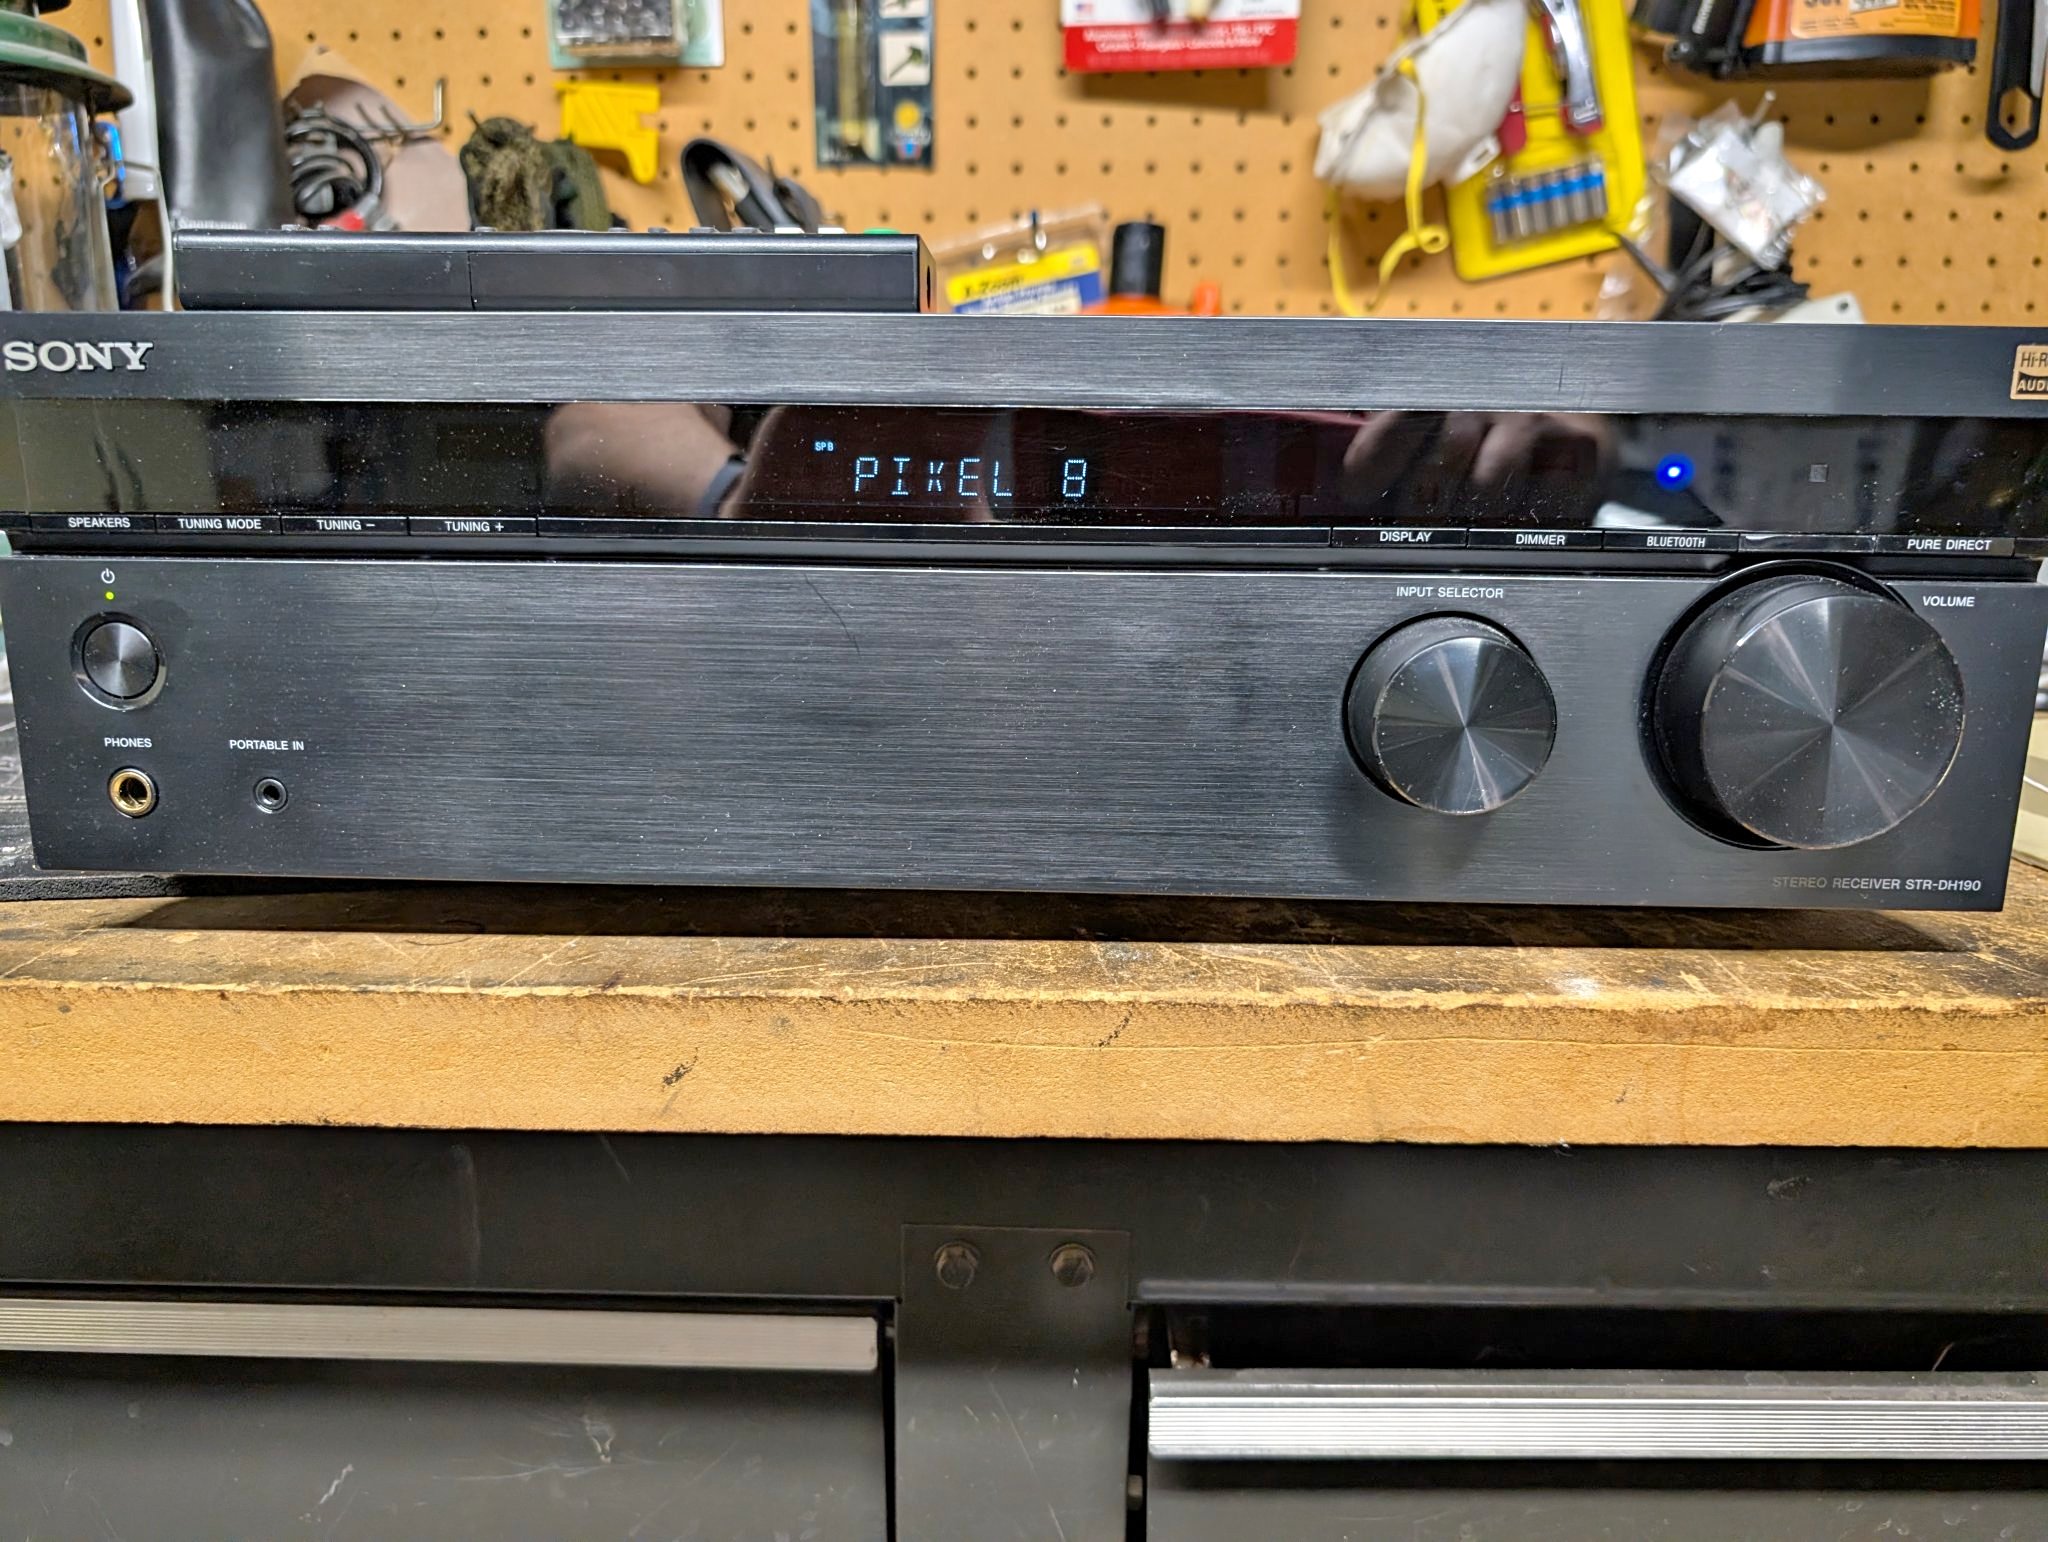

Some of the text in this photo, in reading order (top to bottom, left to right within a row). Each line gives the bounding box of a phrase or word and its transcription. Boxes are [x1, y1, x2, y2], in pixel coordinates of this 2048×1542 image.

[2, 341, 154, 373] SONY
[1063, 459, 1087, 497] 8
[68, 517, 131, 528] SPEAKERS
[178, 518, 262, 530] TUNING MODE
[316, 519, 362, 531] TUNING
[445, 521, 490, 532] TUNING
[1379, 531, 1432, 543] DISPLAY
[1515, 533, 1566, 546] DIMMER
[1646, 536, 1706, 548] BLUETOOTH
[1907, 538, 1992, 551] PURE DIRECT
[1396, 586, 1504, 599] INPUT SELECTOR
[1922, 595, 1976, 608] VOLUME
[104, 737, 152, 749] PHONES
[229, 739, 305, 751] PORTABLE IN
[1772, 876, 1982, 892] STEREO RECEIVER STR-DH190
